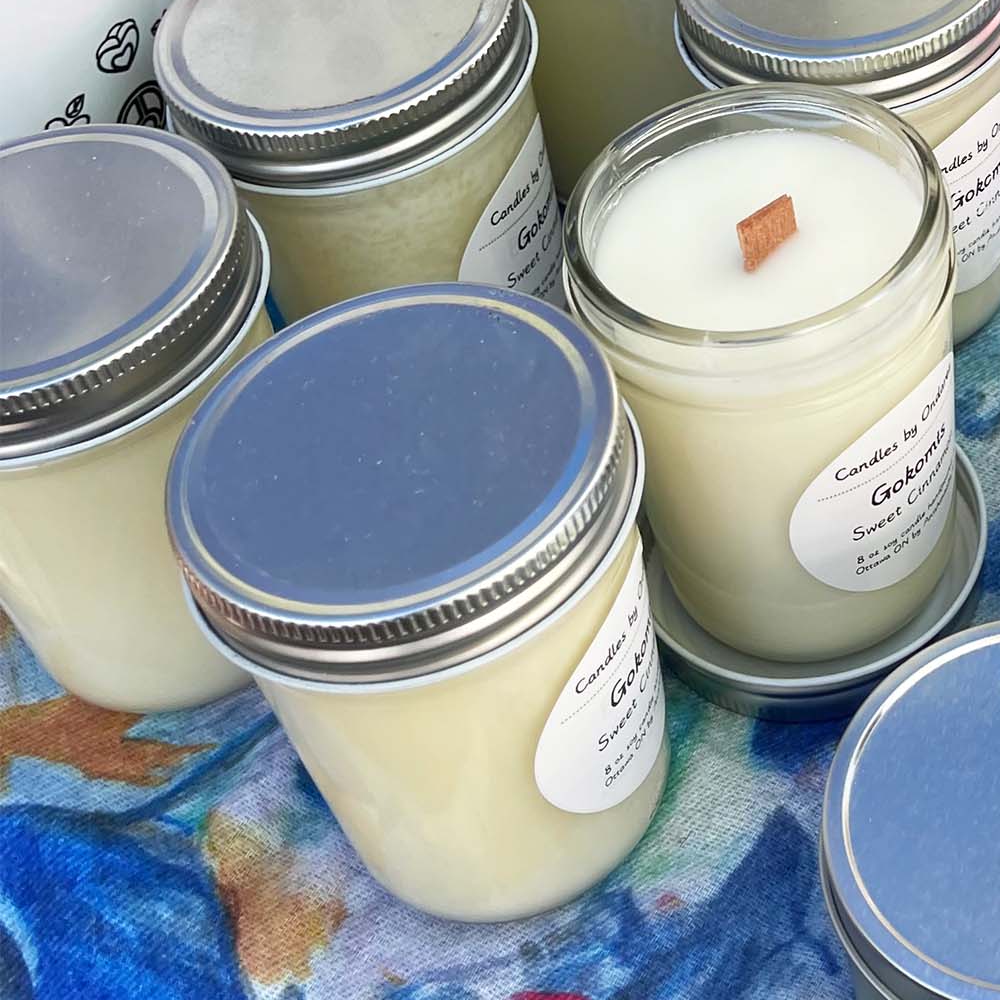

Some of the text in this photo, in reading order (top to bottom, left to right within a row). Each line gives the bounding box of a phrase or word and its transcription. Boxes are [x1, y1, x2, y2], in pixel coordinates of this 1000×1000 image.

[941, 151, 973, 175] ndles
[977, 139, 988, 153] by
[490, 184, 530, 226] Candles
[507, 251, 541, 289] Sweet
[835, 442, 898, 481] Candles
[903, 425, 918, 441] by
[872, 423, 945, 506] Gokomis
[853, 507, 902, 541] Sweet
[856, 528, 921, 575] Ottawa ON by
[857, 556, 865, 564] 8
[869, 550, 879, 558] oz
[575, 606, 638, 694] Candles by
[598, 698, 637, 752] Sweet
[605, 764, 612, 775] 8
